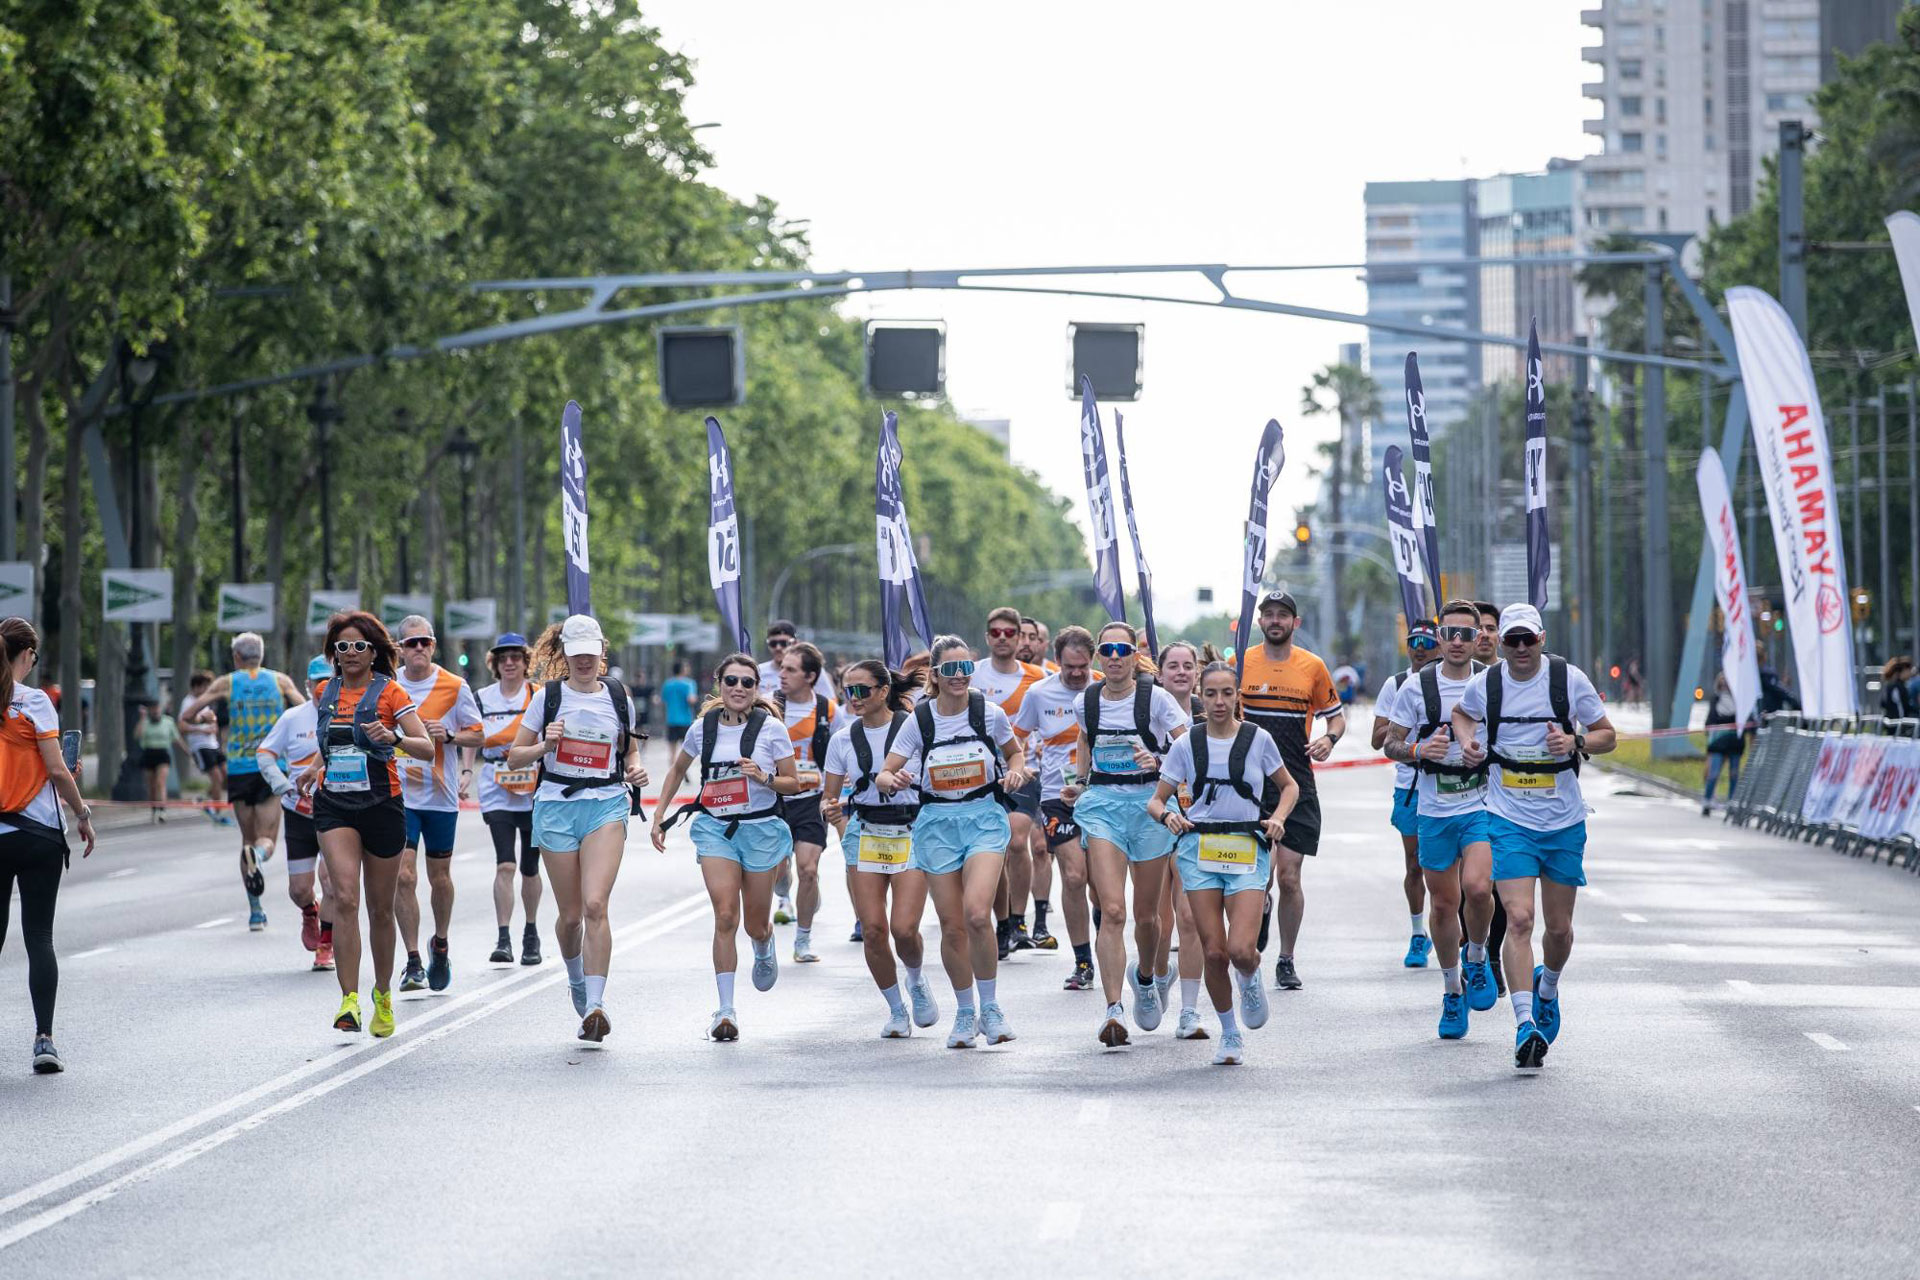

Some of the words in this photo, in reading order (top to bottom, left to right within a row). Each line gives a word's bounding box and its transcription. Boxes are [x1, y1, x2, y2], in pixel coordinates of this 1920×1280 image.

[573, 755, 593, 765] 6952
[712, 795, 733, 804] 7066
[1217, 851, 1237, 859] 2401
